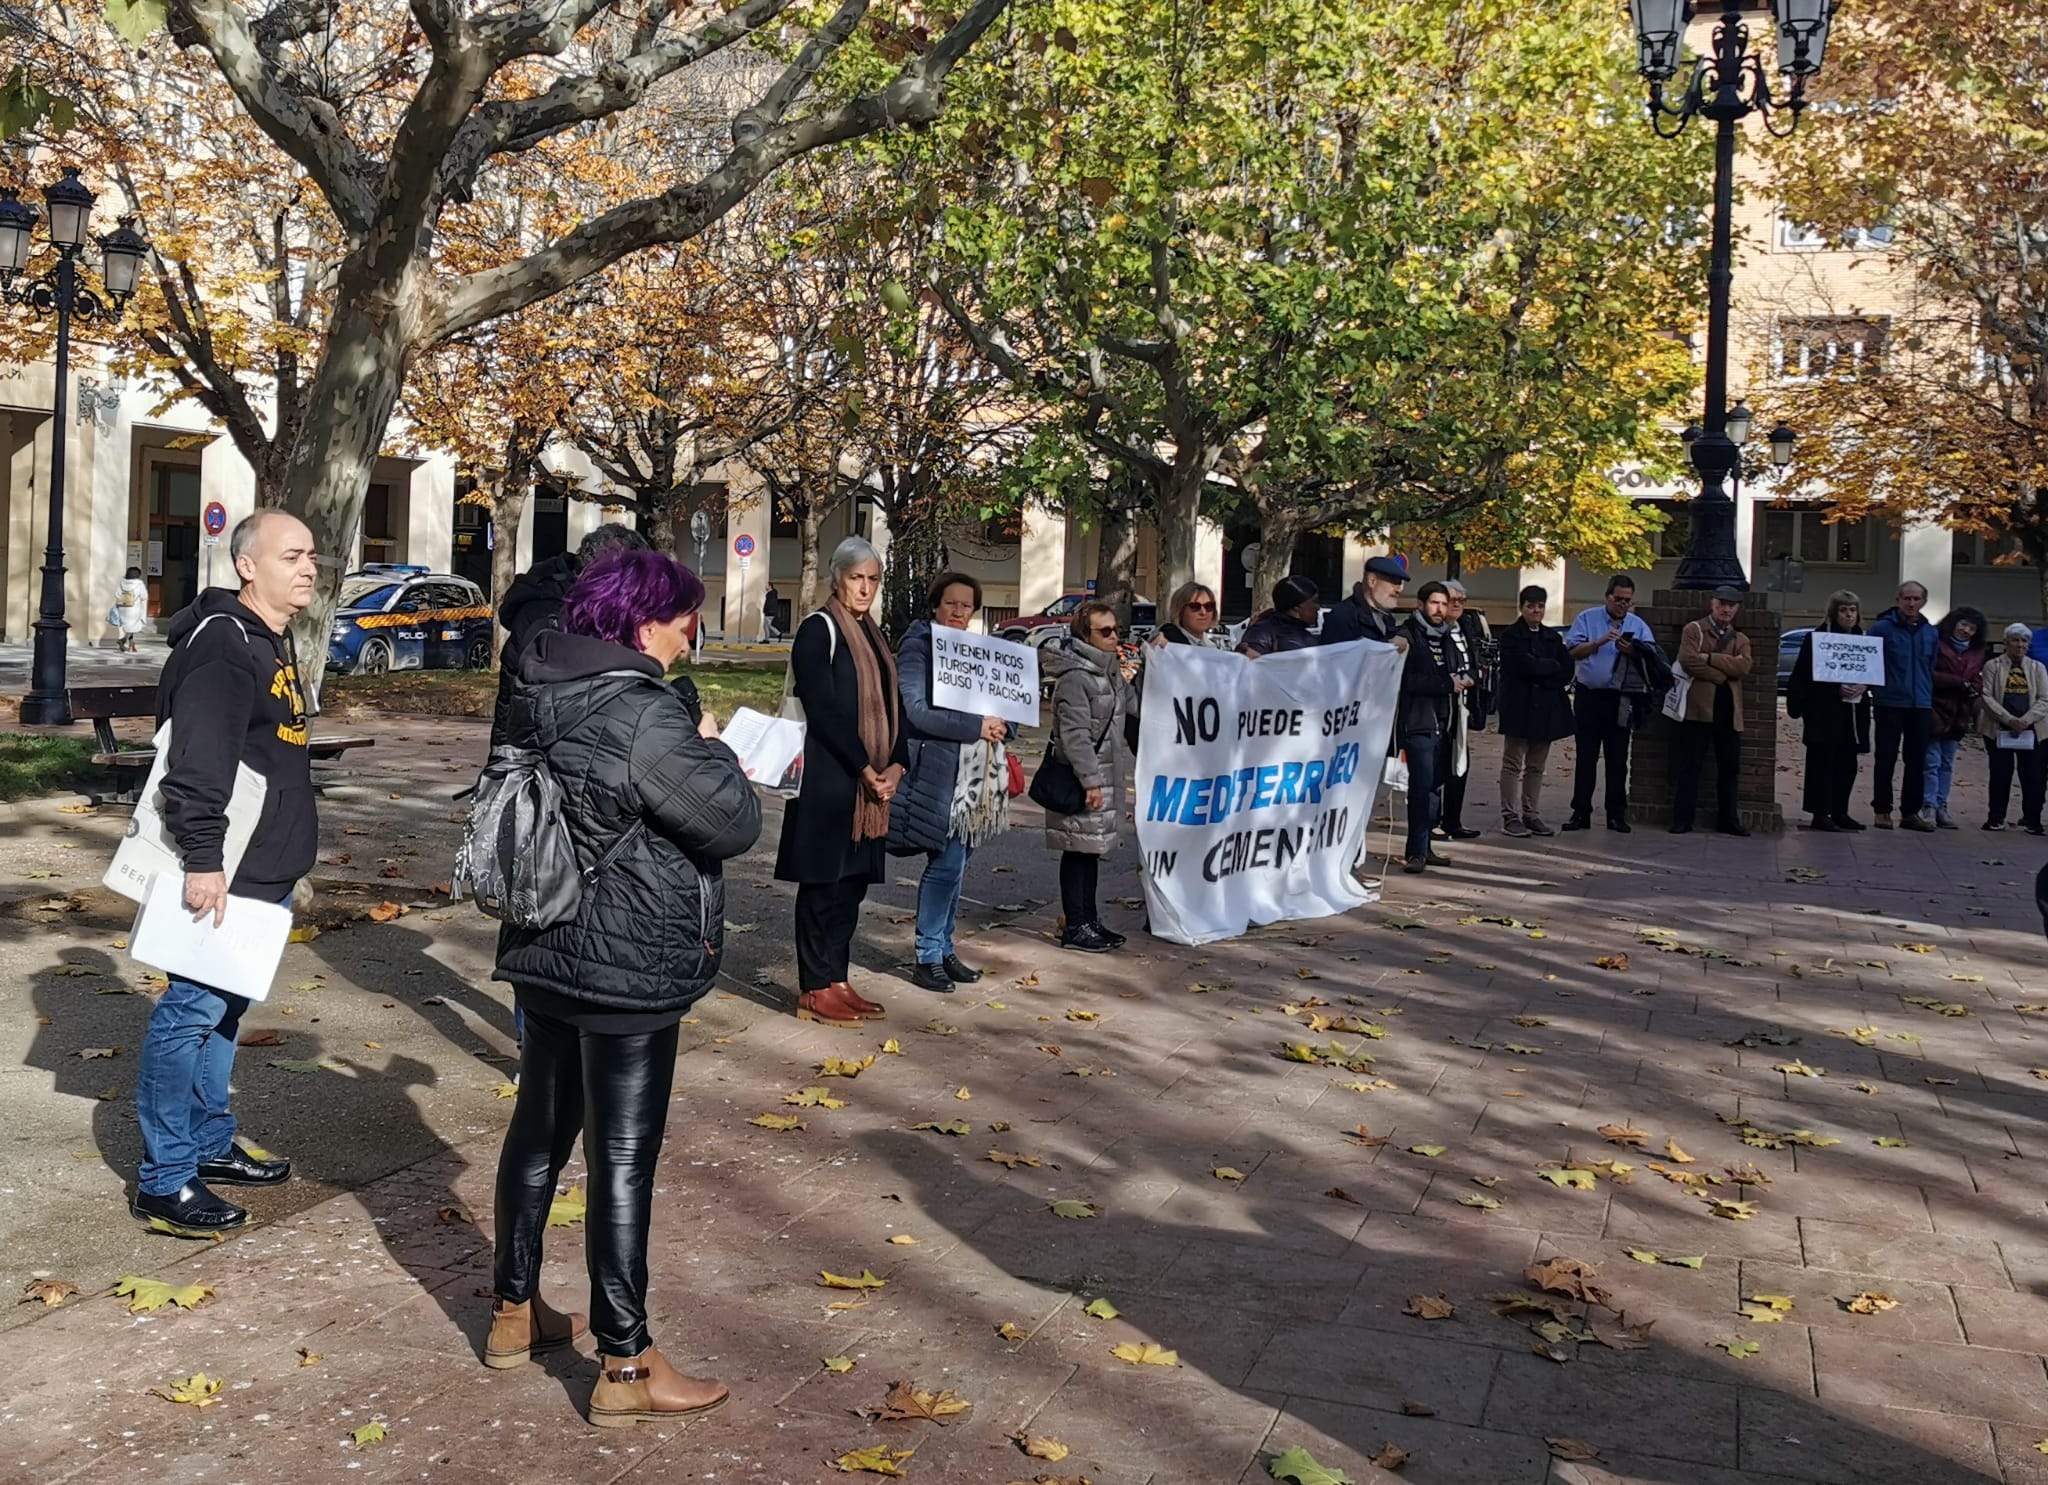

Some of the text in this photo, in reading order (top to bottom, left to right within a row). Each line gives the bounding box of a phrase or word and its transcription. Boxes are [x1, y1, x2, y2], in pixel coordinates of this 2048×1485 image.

[936, 638, 1025, 671] SI VIENEN RICOS
[937, 672, 1032, 705] ABUSO Y RACISMO
[938, 656, 1024, 689] TURISMO, SI NO,
[1173, 696, 1221, 746] NO
[1238, 709, 1303, 740] PUEDE
[1147, 850, 1177, 879] UN
